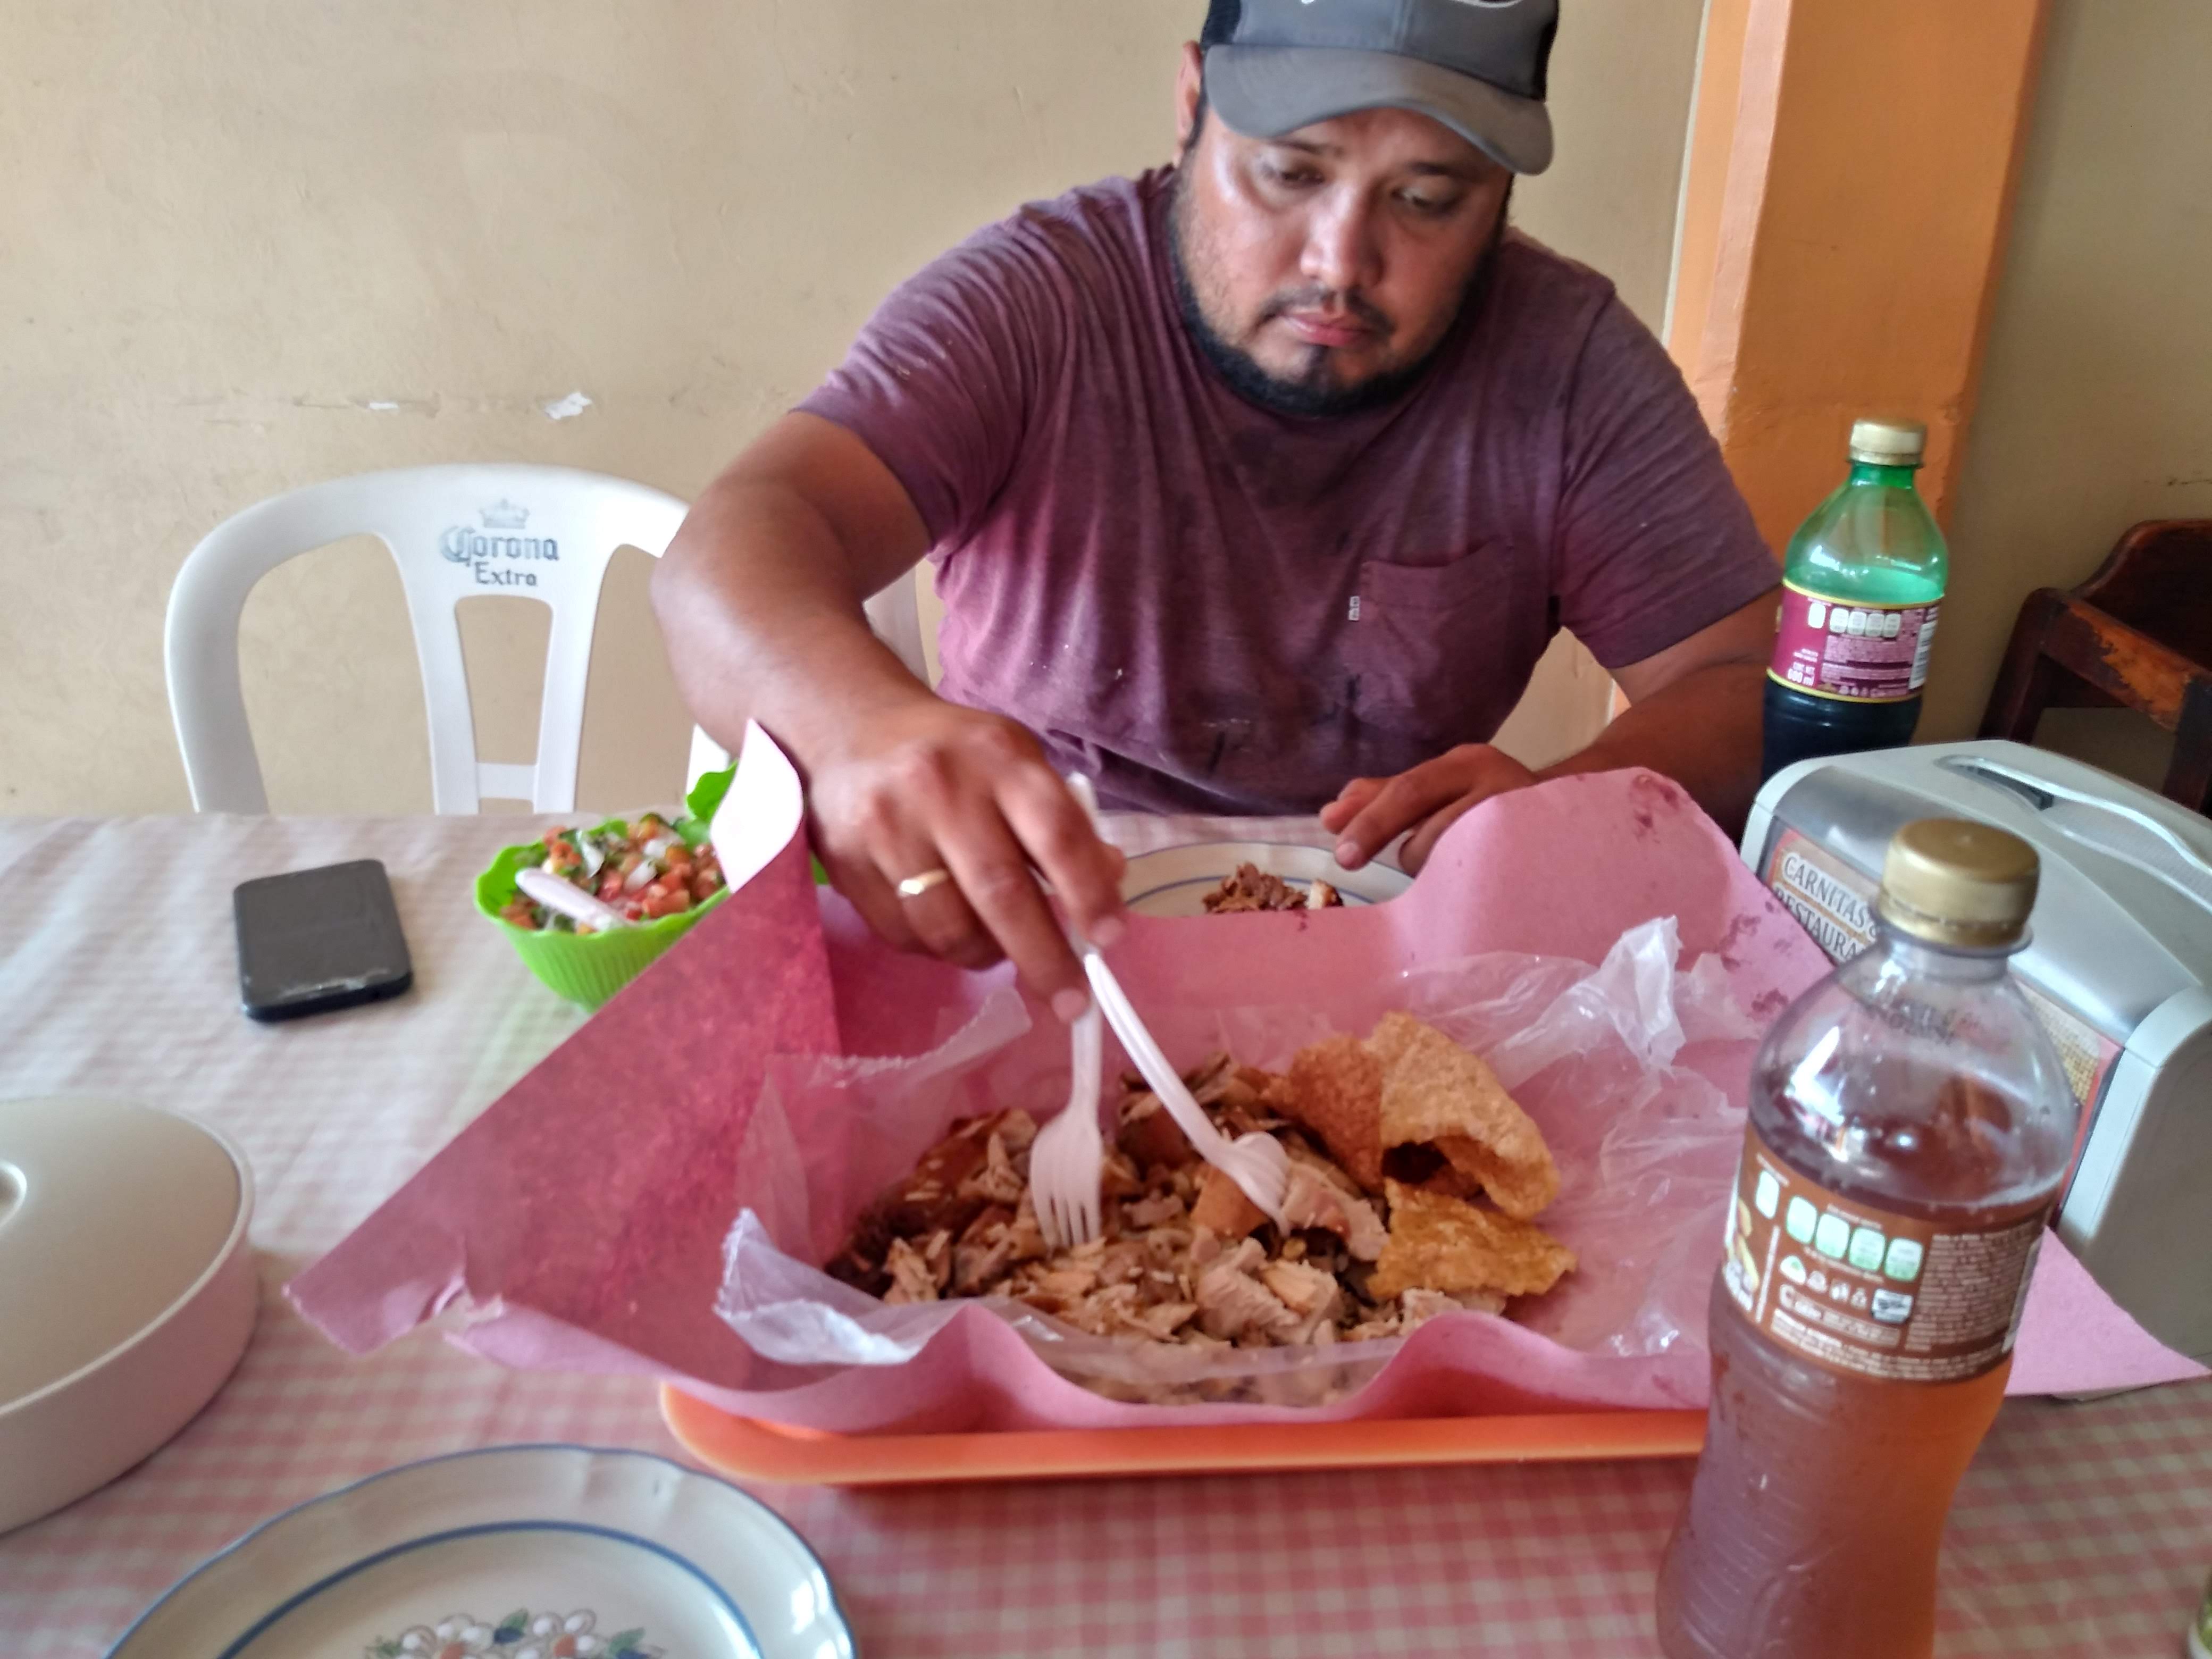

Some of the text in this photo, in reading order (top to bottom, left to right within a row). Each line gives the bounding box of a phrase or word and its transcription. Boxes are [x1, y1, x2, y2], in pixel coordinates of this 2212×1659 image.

[440, 526, 559, 567] Corona
[475, 561, 538, 585] Extra
[1784, 856, 1865, 928] CARNITAS
[1774, 887, 1863, 959] RESTAURA
